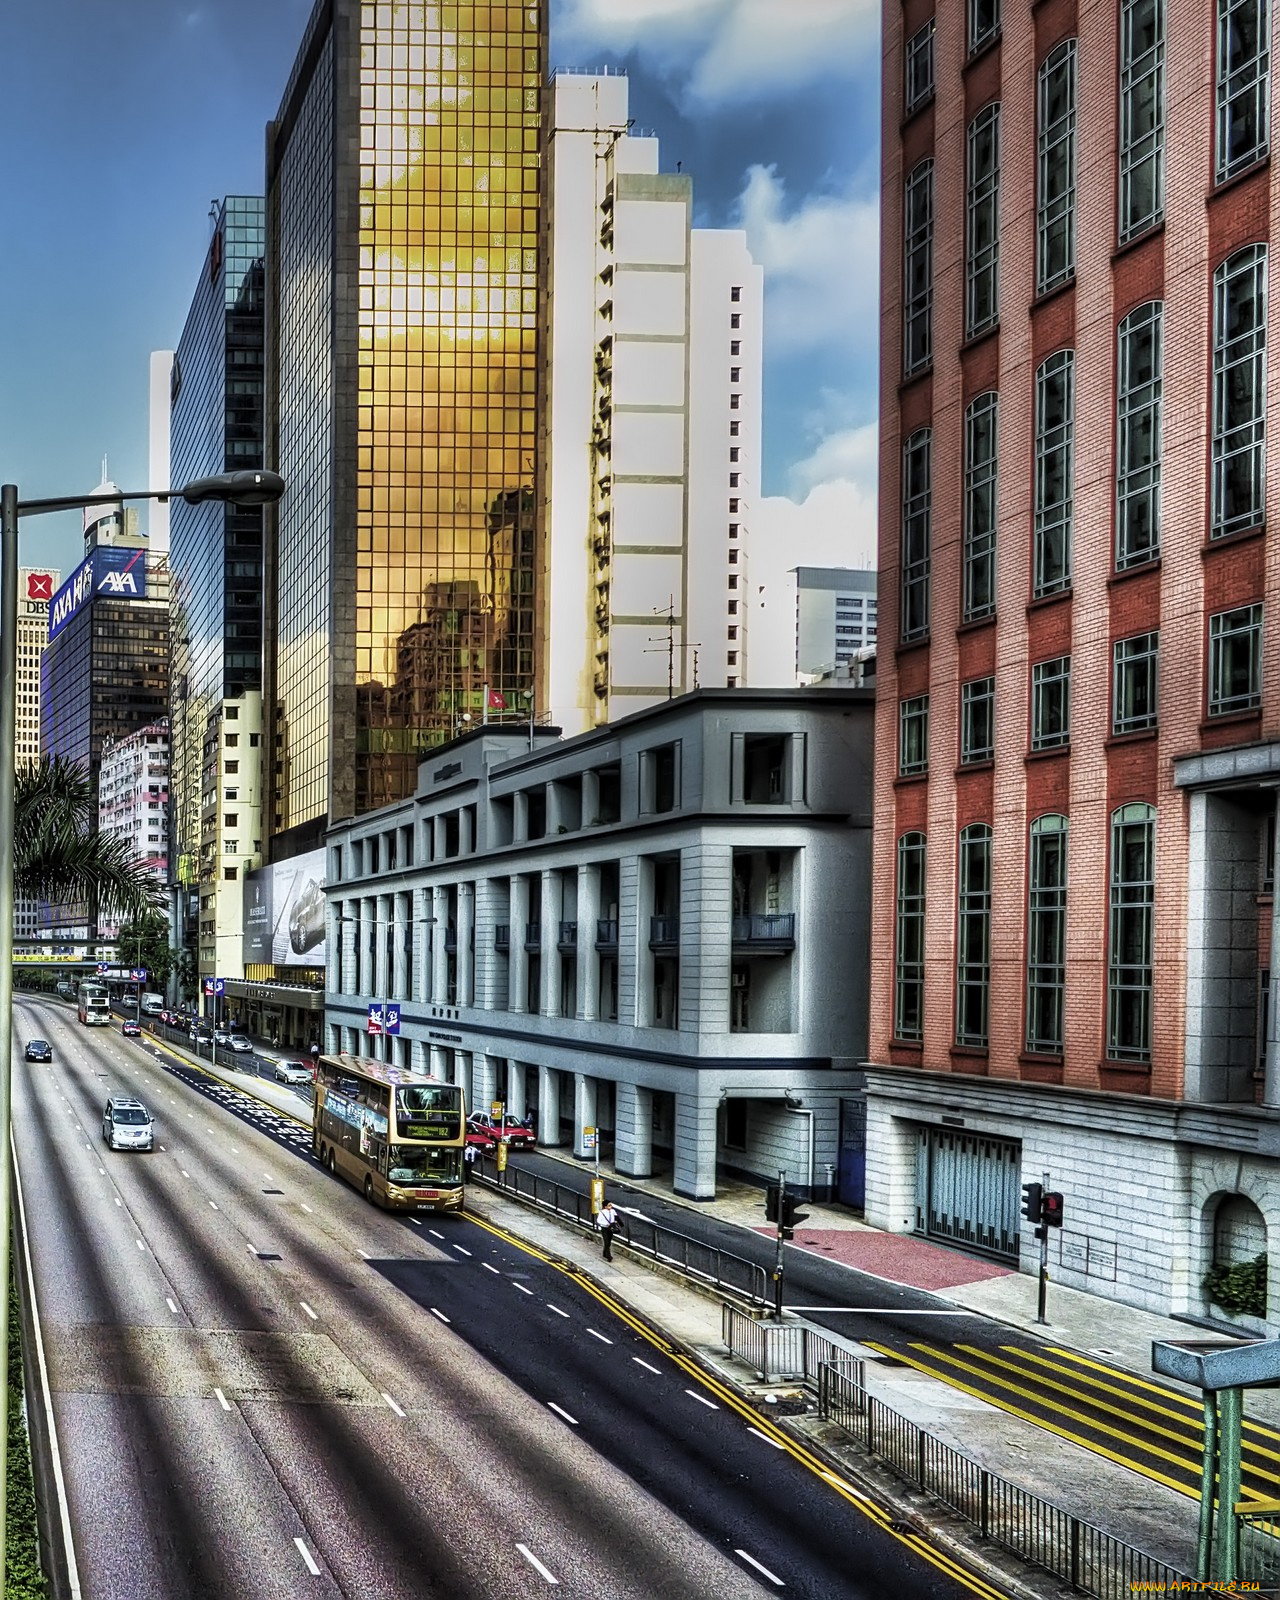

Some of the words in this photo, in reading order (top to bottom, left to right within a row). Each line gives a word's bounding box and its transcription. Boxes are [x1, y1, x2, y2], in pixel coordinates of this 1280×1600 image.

[97, 571, 138, 593] AXA
[27, 601, 50, 614] DBS
[52, 588, 72, 631] AXA
